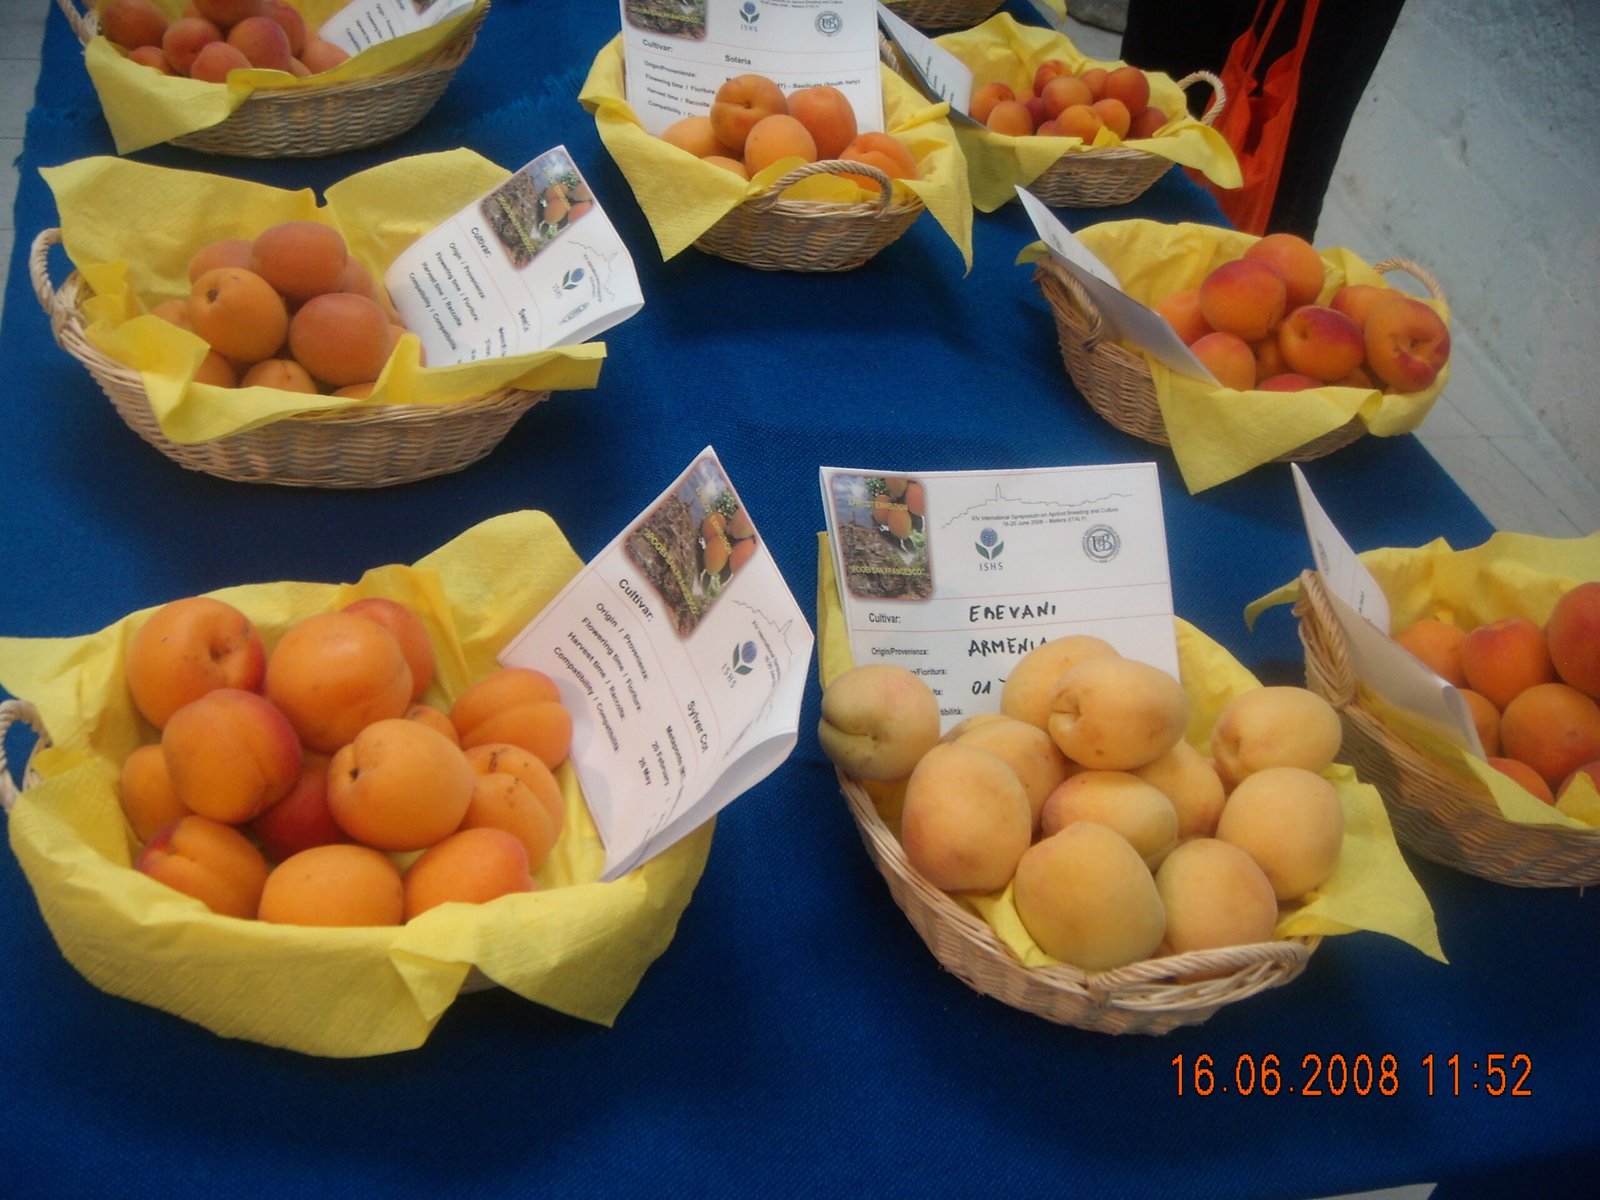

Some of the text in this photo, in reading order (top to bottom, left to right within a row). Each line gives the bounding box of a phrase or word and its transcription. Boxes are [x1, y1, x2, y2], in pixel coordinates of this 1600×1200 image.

[643, 39, 673, 52] Cultivar:
[725, 54, 751, 65] Solaria
[979, 562, 1004, 571] ISHS
[618, 578, 654, 622] Cultivar:
[596, 602, 618, 628] Origin
[869, 613, 902, 624] Cultivar:
[567, 632, 594, 663] Harvest
[592, 660, 607, 680] time
[581, 617, 614, 656] Flowering
[612, 653, 624, 672] time
[870, 648, 929, 658] Origin/Provenienza:
[553, 647, 594, 696] Compatibility
[721, 663, 737, 689] ISHS
[687, 700, 703, 733] Sylver
